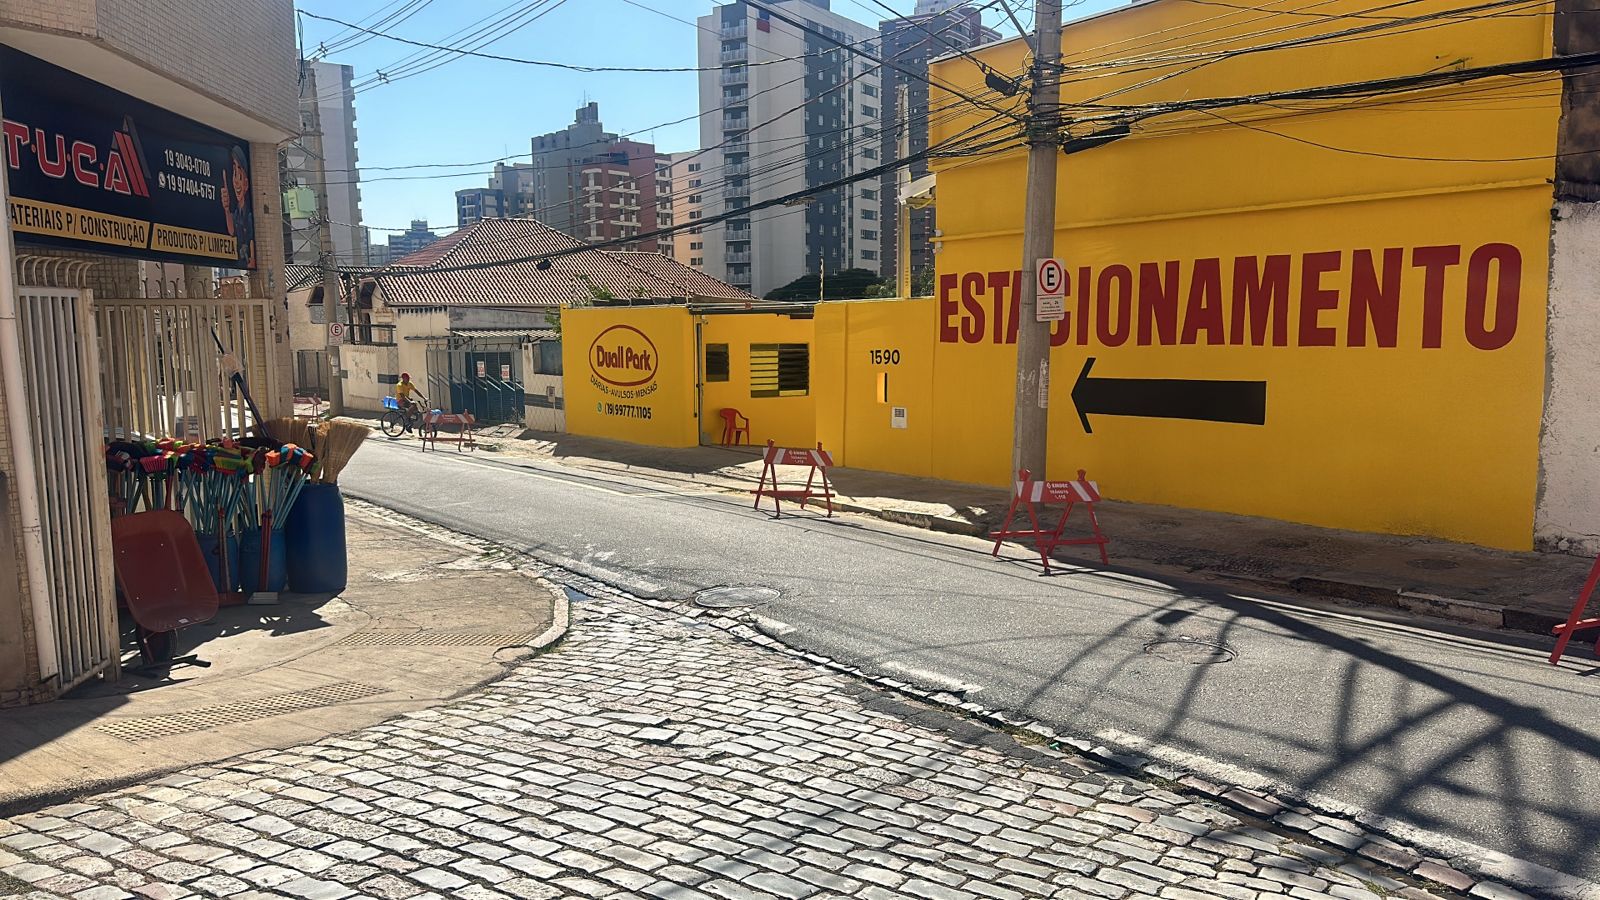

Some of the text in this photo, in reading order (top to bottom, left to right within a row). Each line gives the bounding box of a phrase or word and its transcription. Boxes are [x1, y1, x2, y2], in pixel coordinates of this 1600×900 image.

[164, 148, 211, 177] 19 3043-0708
[166, 173, 216, 200] 19 97404-6757
[10, 203, 145, 246] ATERIAIS P/ CONSTRUÇÃO
[157, 229, 236, 255] PRODUTOS P/ LIMPEZA
[1046, 267, 1055, 286] E
[334, 325, 340, 334] E
[596, 345, 652, 371] Duall Park
[870, 349, 900, 365] 1590
